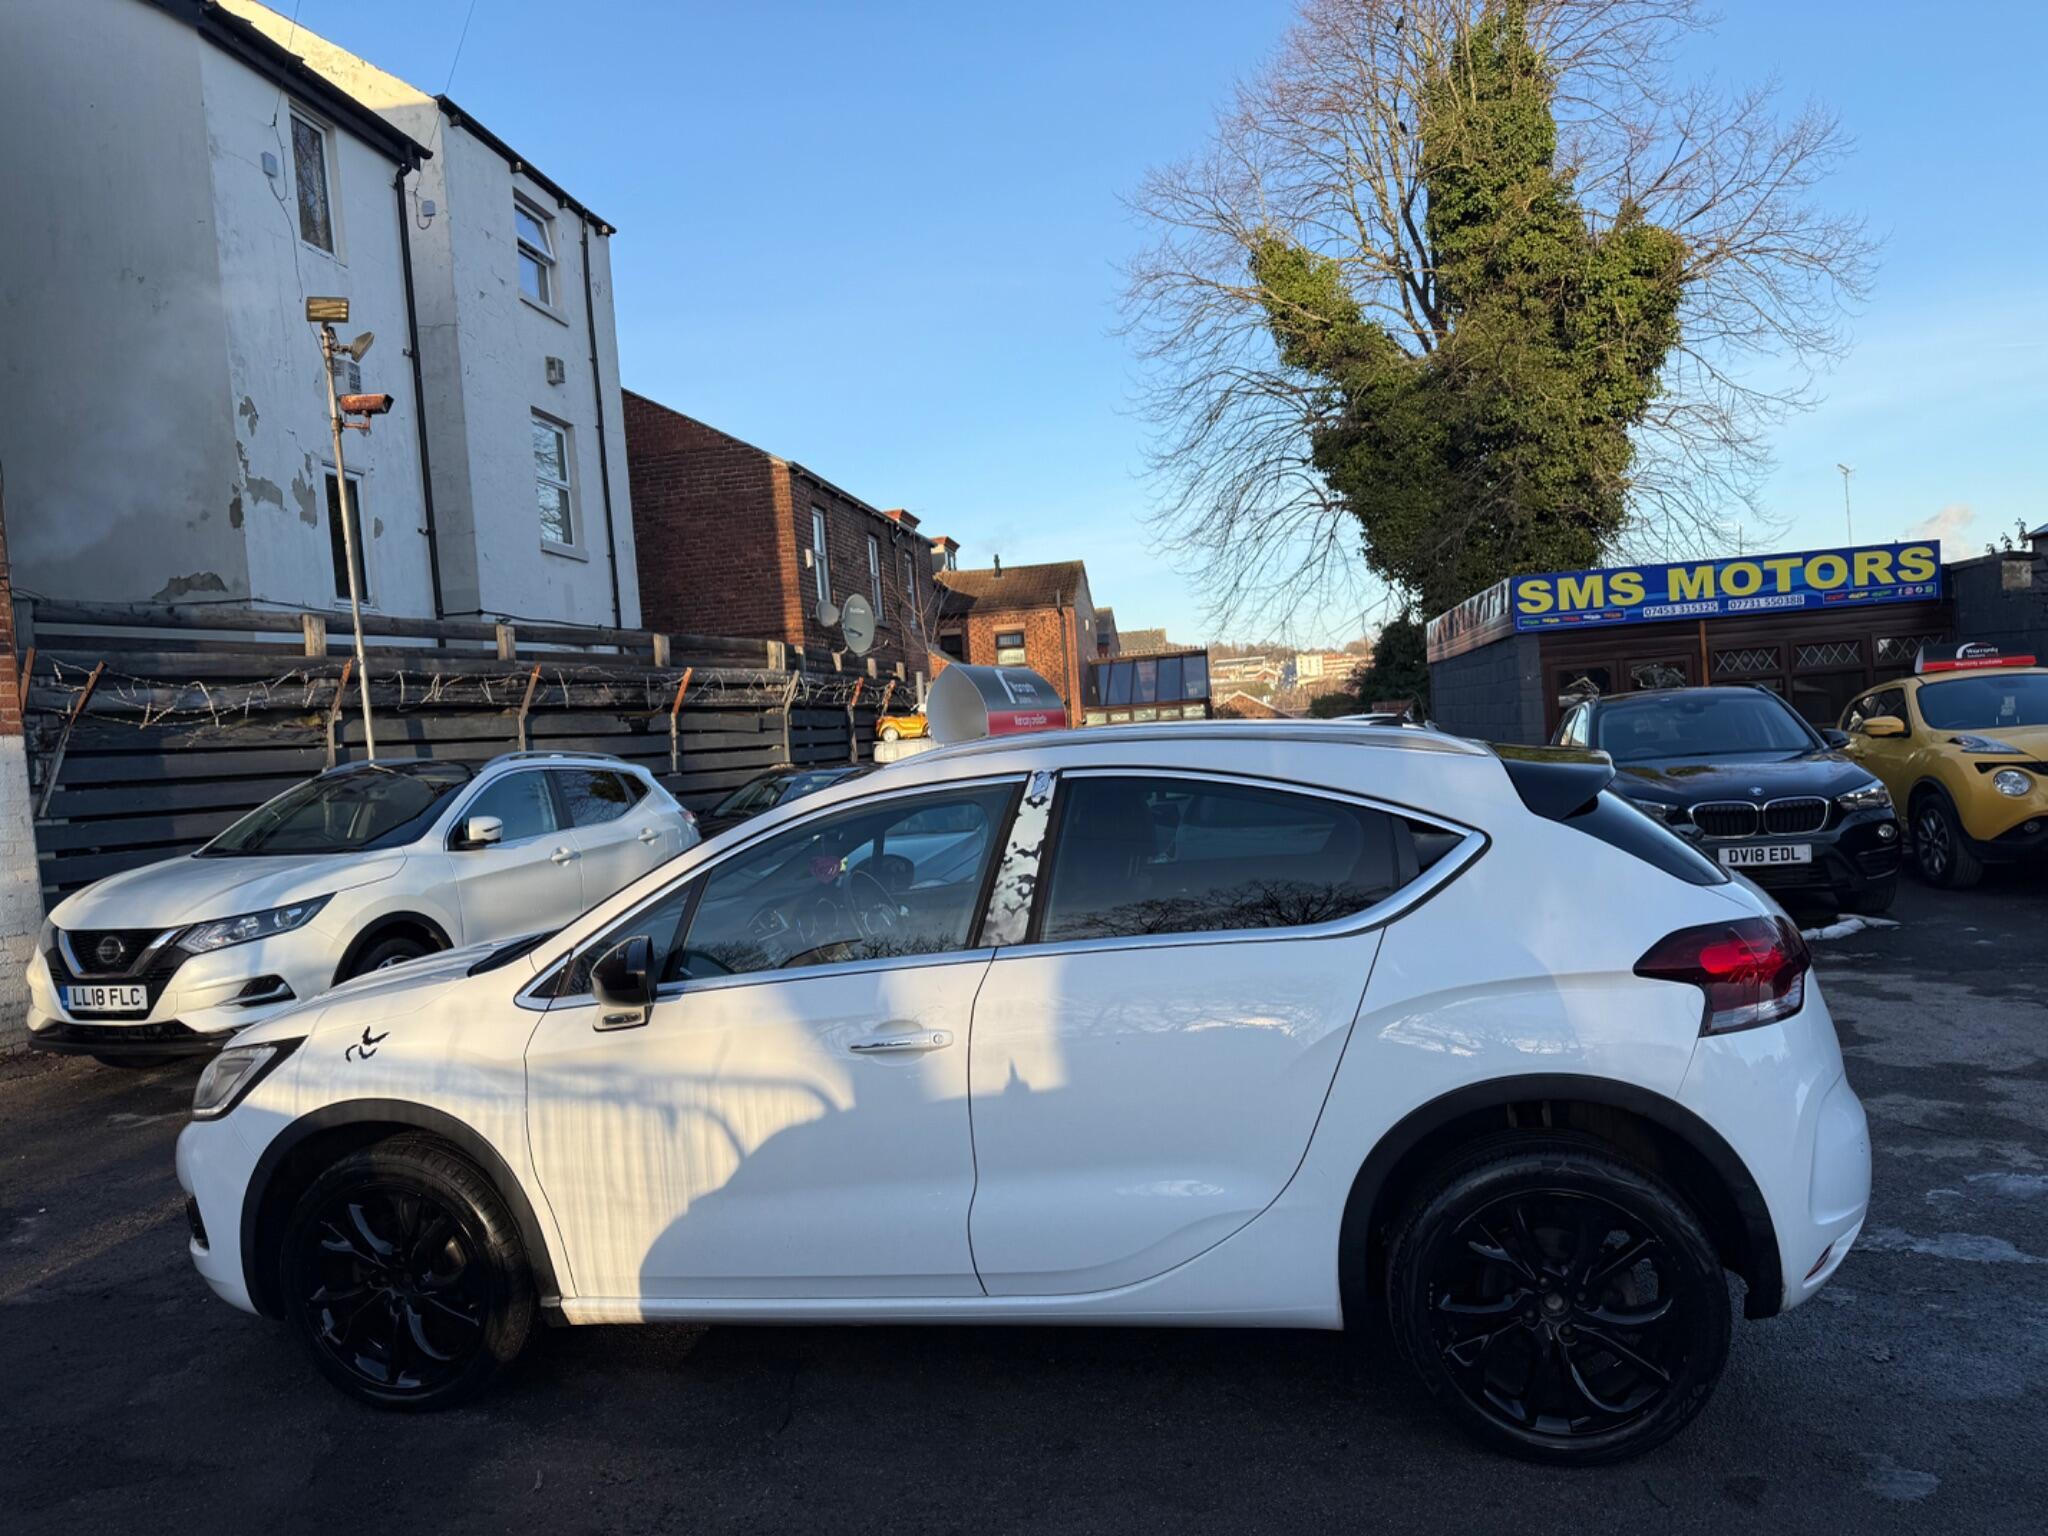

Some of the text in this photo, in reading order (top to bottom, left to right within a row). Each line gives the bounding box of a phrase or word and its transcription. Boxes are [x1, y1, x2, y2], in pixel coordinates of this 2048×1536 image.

[1517, 546, 1936, 614] SMS MOTORS
[1728, 847, 1802, 863] DV18 EDL
[73, 988, 140, 1006] LL18 FLC
